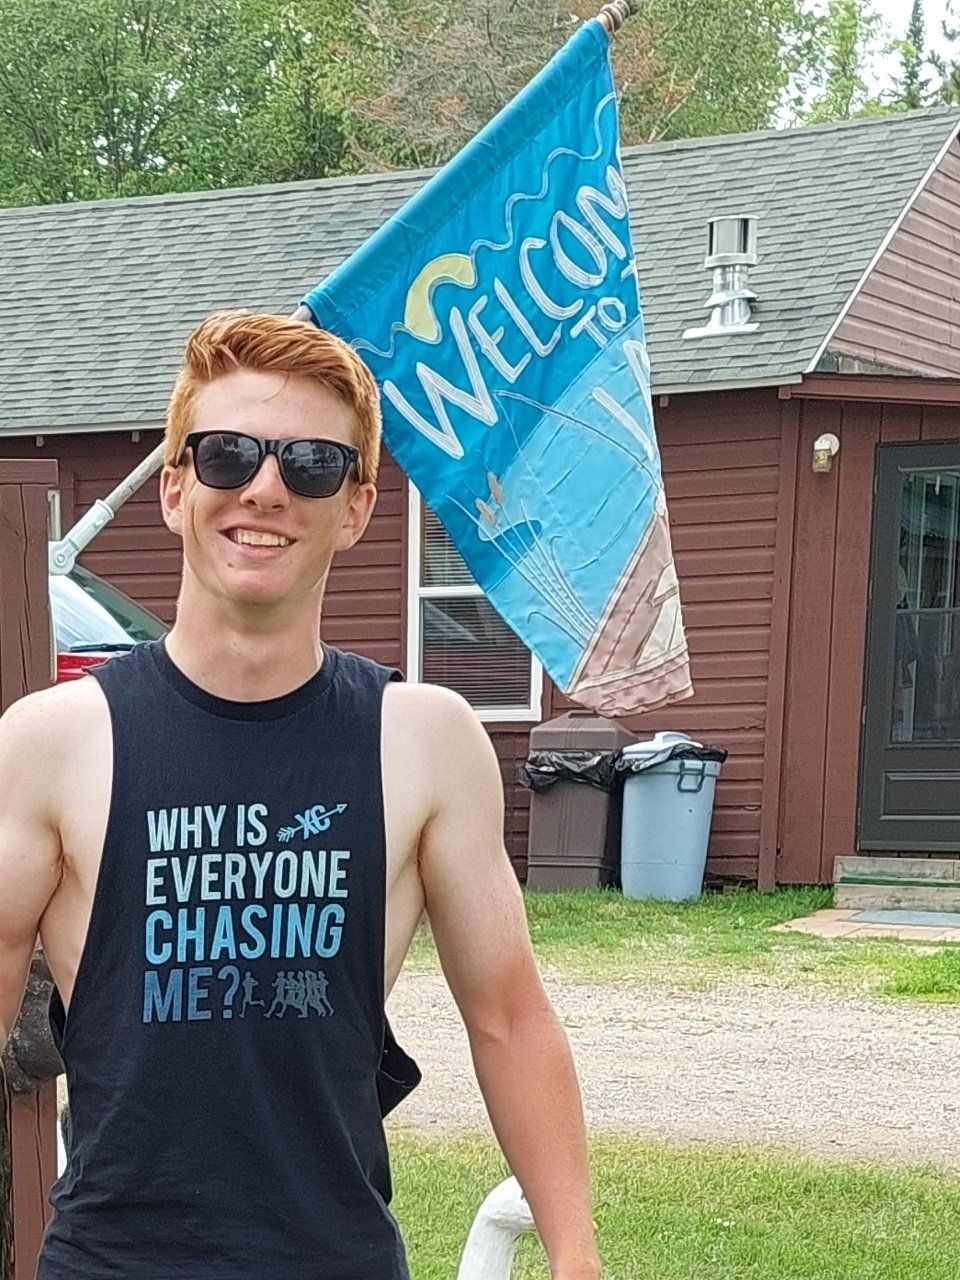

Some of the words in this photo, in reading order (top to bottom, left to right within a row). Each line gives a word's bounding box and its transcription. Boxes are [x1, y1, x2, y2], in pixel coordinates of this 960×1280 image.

[383, 164, 630, 460] WELCOM
[570, 296, 628, 348] TO
[147, 804, 227, 852] WHY
[236, 803, 269, 847] IS
[145, 850, 351, 906] EVERYONE
[145, 903, 346, 965] CHASING
[142, 965, 240, 1023] ME?
